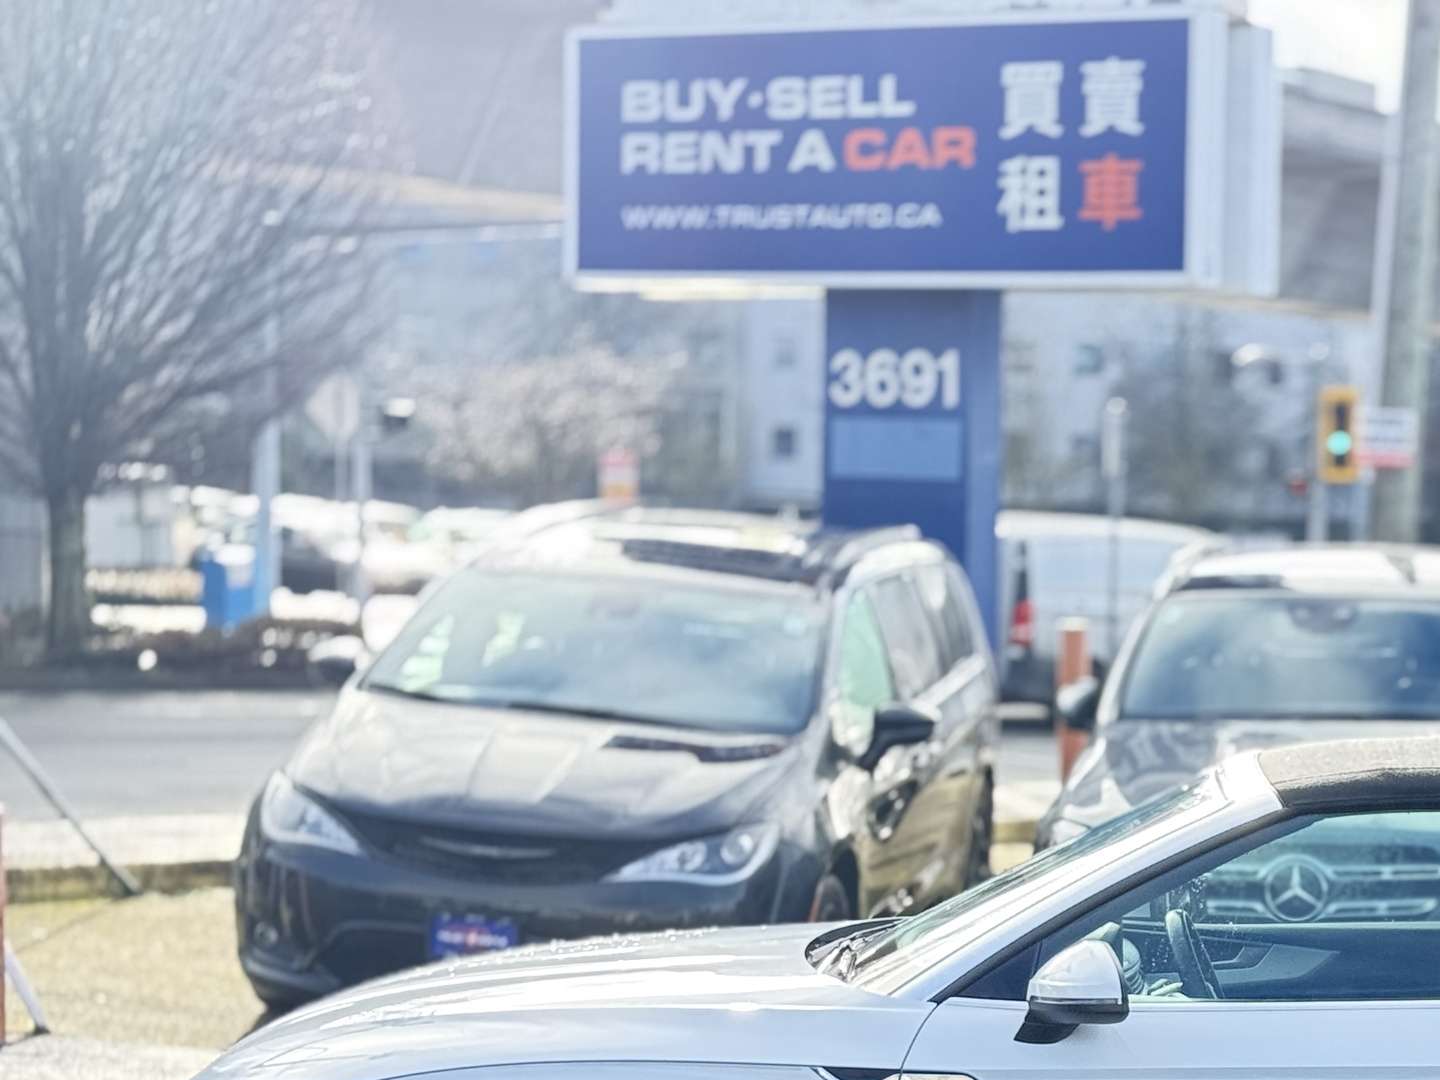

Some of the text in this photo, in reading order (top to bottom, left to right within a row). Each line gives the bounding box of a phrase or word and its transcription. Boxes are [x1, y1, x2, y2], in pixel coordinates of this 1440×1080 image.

[999, 55, 1146, 140] 買賣
[620, 126, 977, 174] RENT A CAR
[620, 202, 942, 231] WWW.TRUSTAUTO.CA
[997, 152, 1143, 232] 租車
[828, 348, 961, 409] 3691
